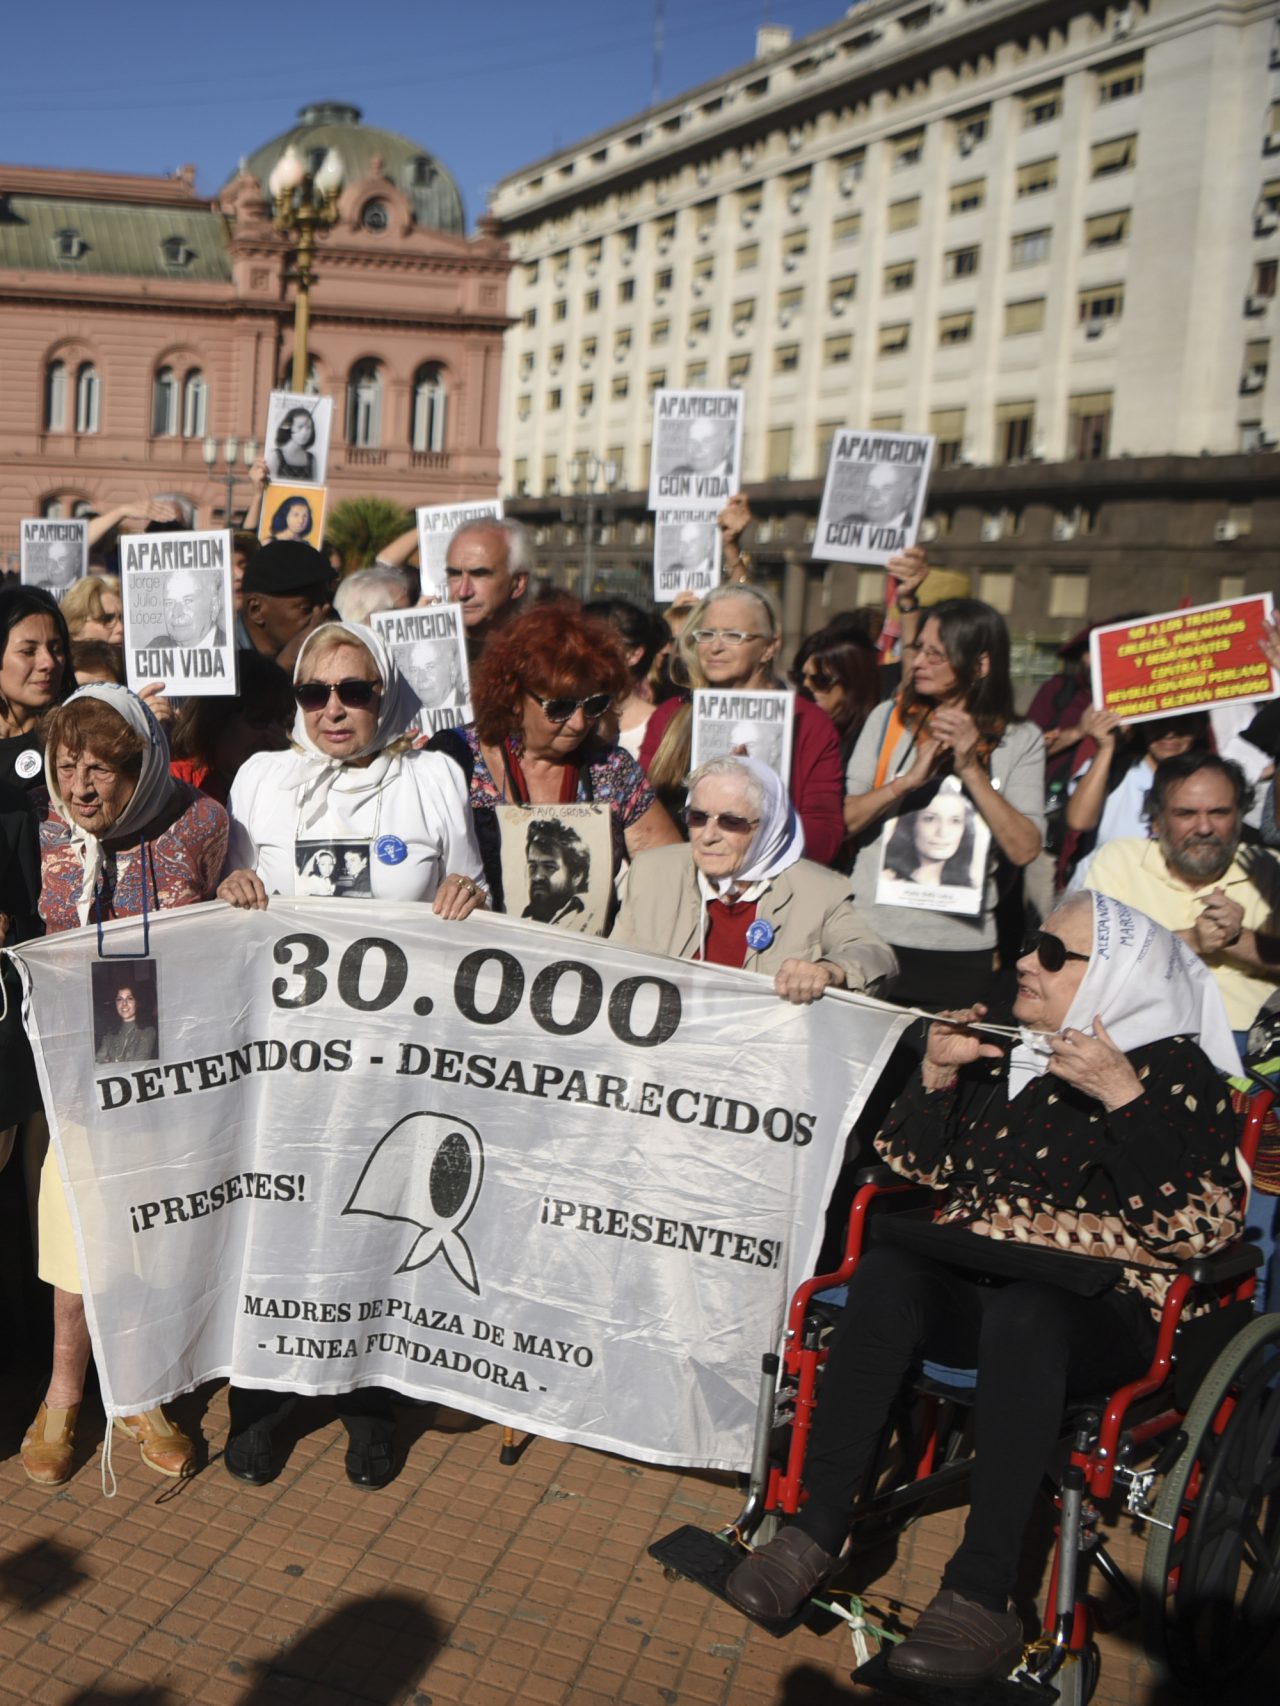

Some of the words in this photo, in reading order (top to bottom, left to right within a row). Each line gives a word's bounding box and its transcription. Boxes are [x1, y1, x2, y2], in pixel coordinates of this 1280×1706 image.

[659, 397, 737, 418] APARICION
[837, 437, 928, 464] APARICION
[658, 476, 690, 497] CON
[695, 476, 729, 497] VIDA
[25, 524, 84, 541] APARICION
[826, 523, 863, 547] CON
[867, 527, 906, 551] VIDA
[127, 539, 224, 571] APARICION
[129, 575, 160, 592] Jorge
[659, 571, 680, 590] CON
[684, 572, 711, 590] VIDA
[133, 595, 158, 608] Julio
[135, 650, 175, 678] CON
[180, 649, 225, 678] VIDA
[699, 696, 786, 722] APARICION
[272, 932, 681, 1048] 30.000
[370, 1056, 384, 1064] -
[396, 1043, 818, 1147] DESAPARECIDOS
[540, 1197, 782, 1269] ¡PRESENTES!
[244, 1295, 352, 1323] MADRES
[358, 1300, 384, 1321] DE
[385, 1298, 465, 1335] PLAZA
[472, 1319, 505, 1346] DE
[513, 1331, 594, 1368] MAYO
[276, 1335, 358, 1359] LINEA
[365, 1333, 530, 1392] FUNDADORA
[538, 1385, 548, 1393] -
